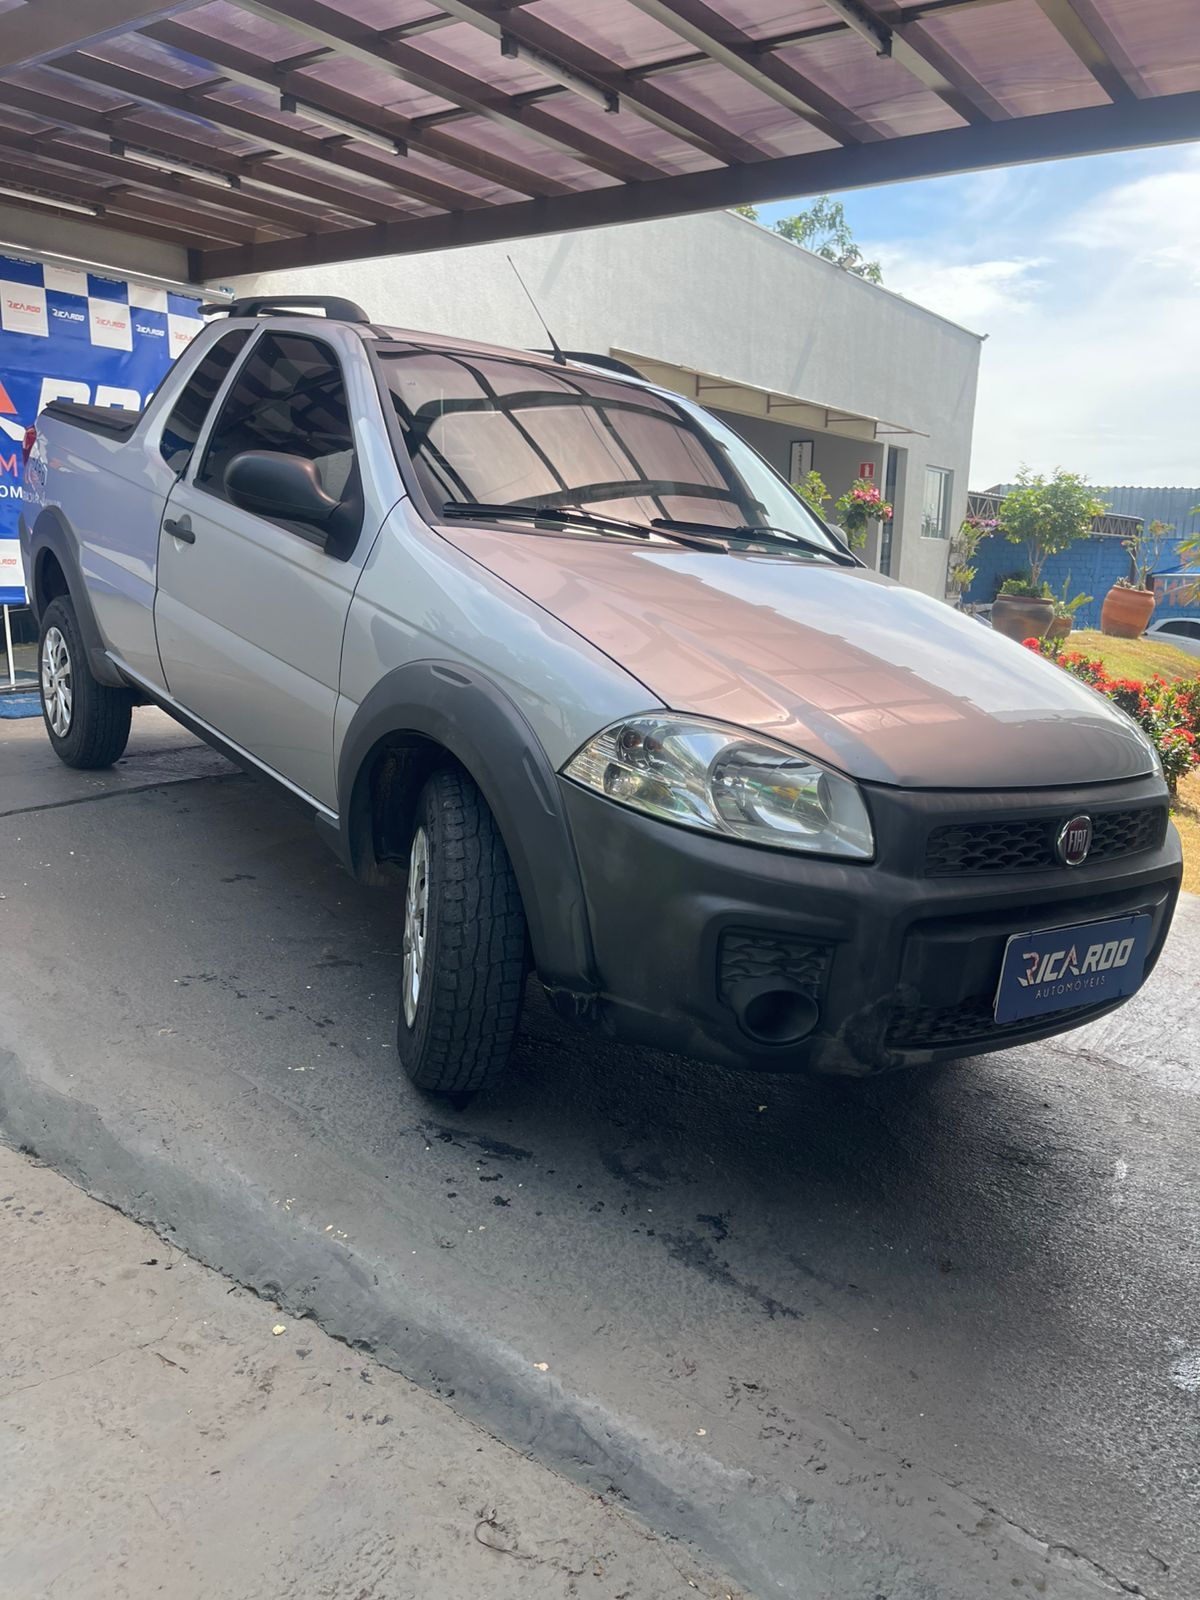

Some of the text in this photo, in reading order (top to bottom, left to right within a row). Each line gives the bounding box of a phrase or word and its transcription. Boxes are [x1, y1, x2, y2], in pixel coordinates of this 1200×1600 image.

[7, 301, 41, 313] RICARDO
[52, 308, 85, 321] RICARDO
[95, 317, 126, 329] RICARDO
[136, 324, 165, 337] RICARDO
[1068, 829, 1088, 853] FIAT
[1017, 938, 1136, 987] RICARDO
